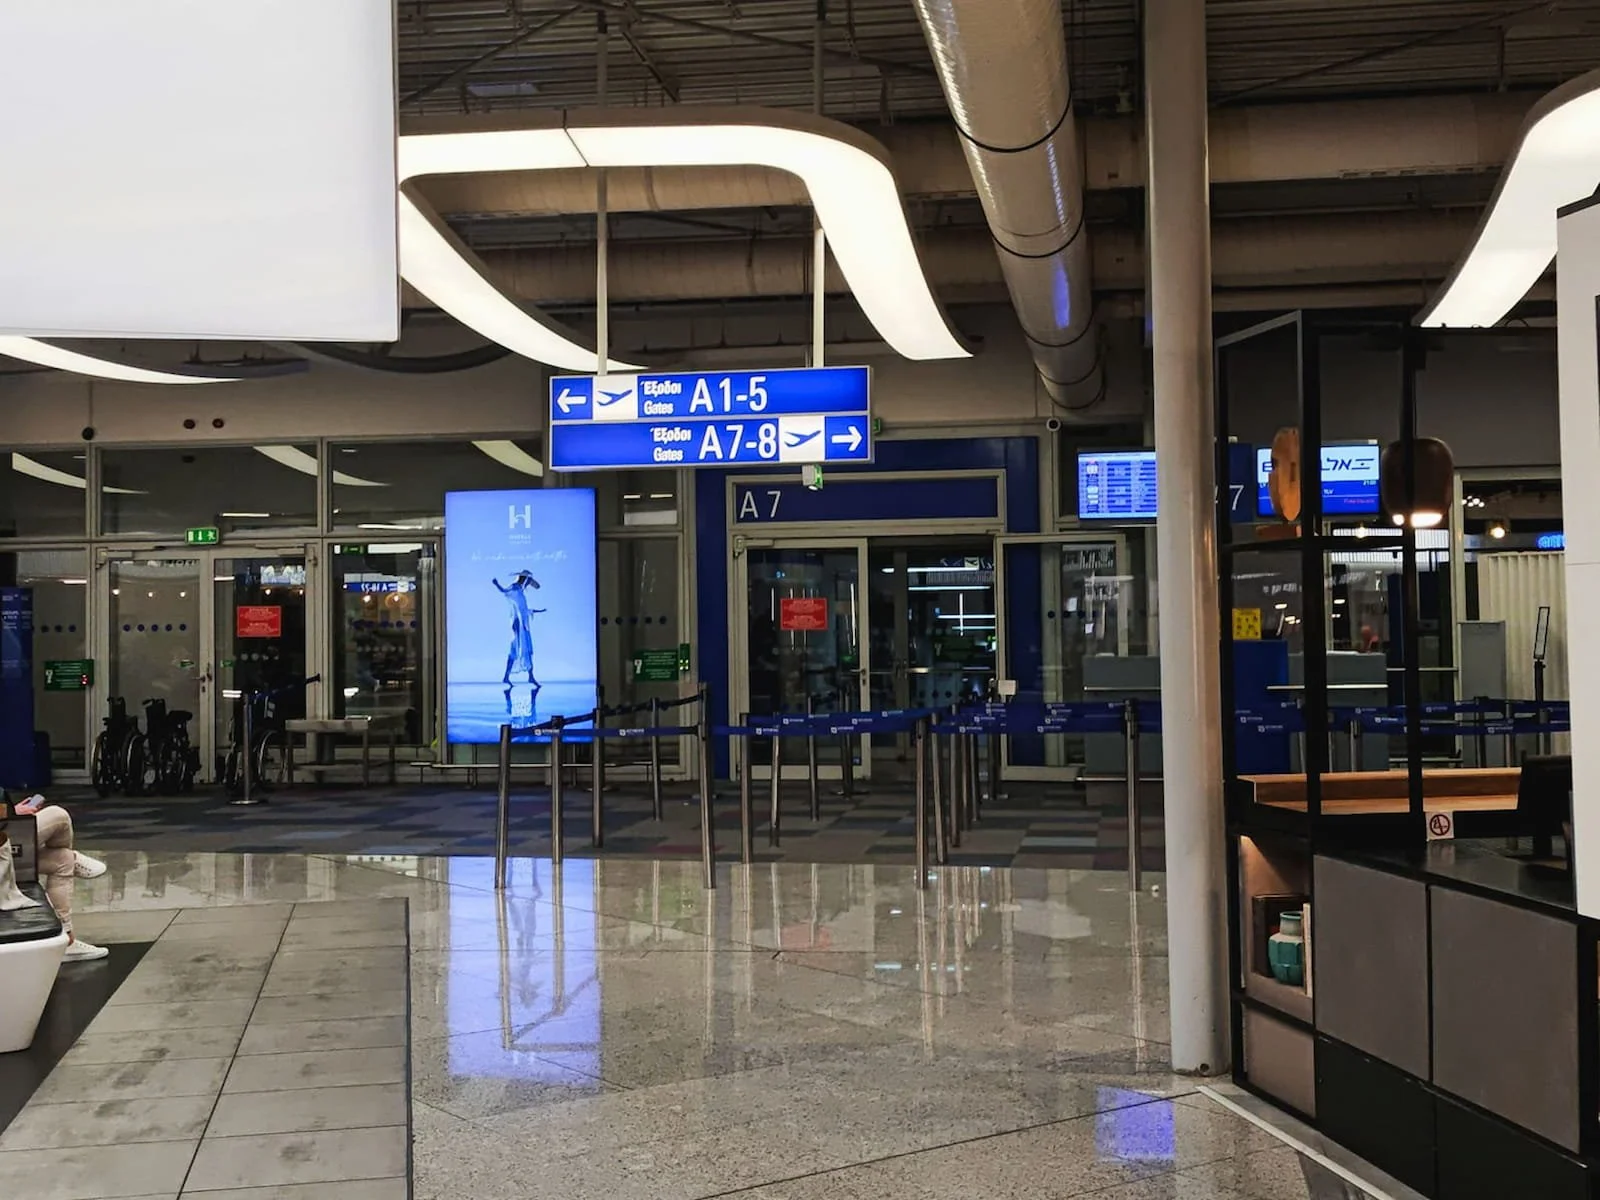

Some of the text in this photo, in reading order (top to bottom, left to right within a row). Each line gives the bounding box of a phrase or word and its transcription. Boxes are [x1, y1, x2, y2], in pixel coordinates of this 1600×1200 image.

[643, 400, 674, 415] Gates
[653, 447, 683, 461] Gates
[739, 490, 781, 519] A 7
[1229, 484, 1244, 510] 7
